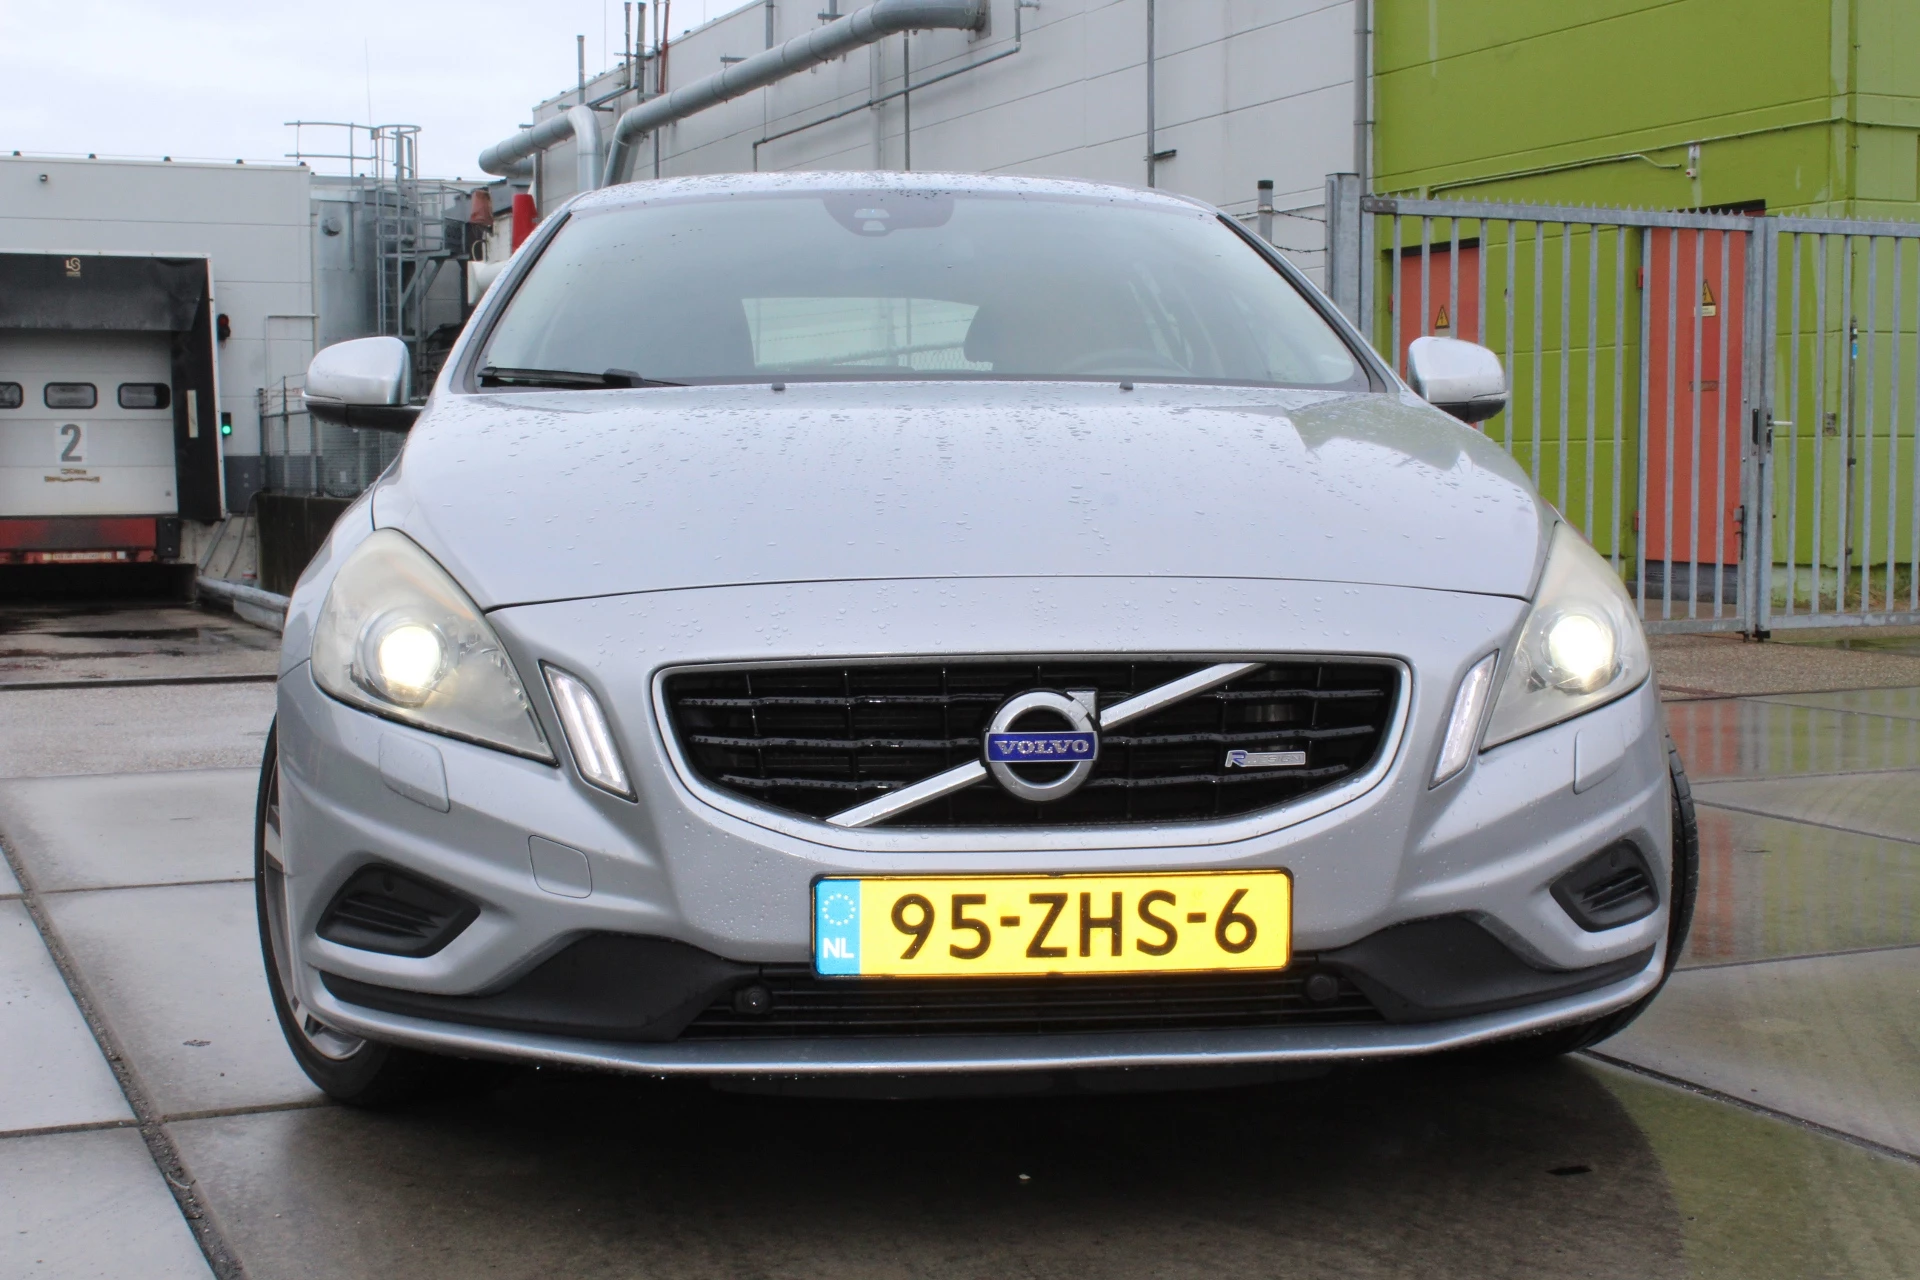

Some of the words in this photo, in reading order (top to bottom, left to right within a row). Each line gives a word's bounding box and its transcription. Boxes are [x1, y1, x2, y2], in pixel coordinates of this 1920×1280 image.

[61, 424, 82, 462] 2
[994, 739, 1089, 754] VOLVO
[891, 888, 1258, 960] 95-ZHS-6
[823, 937, 854, 958] NL
